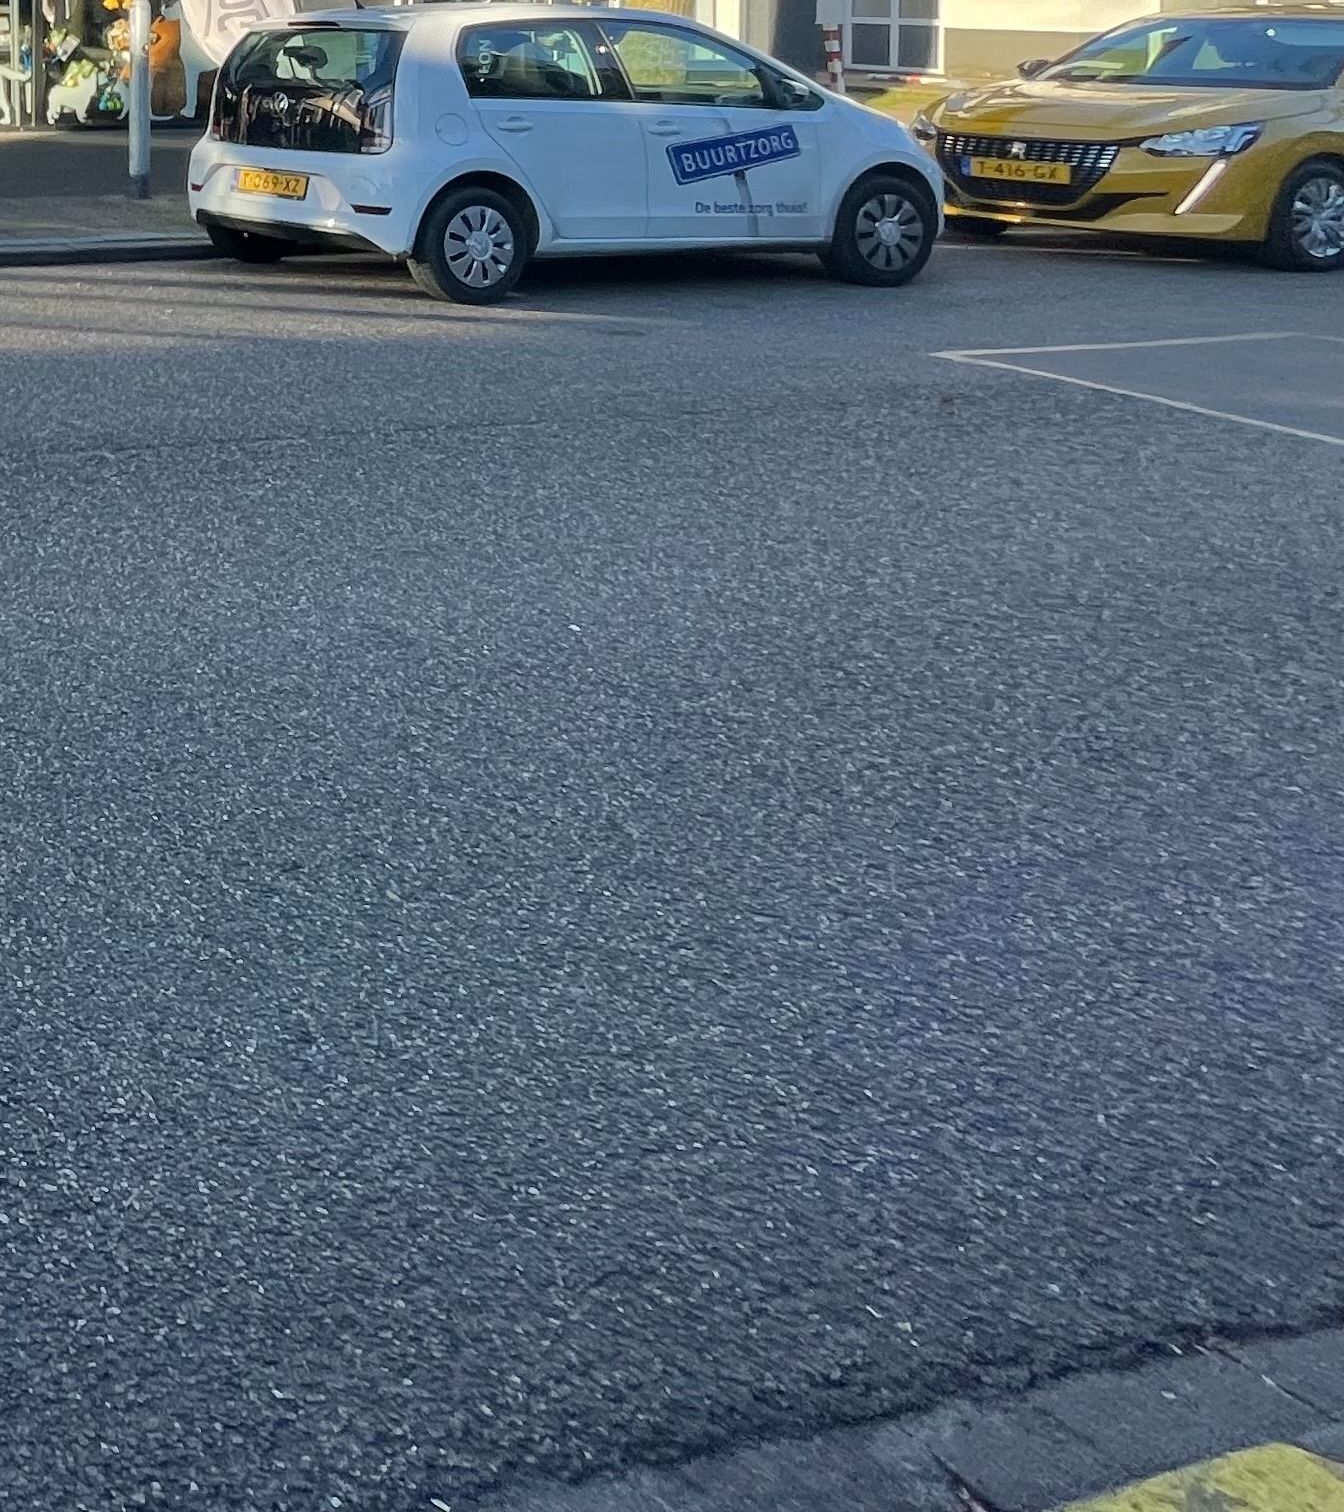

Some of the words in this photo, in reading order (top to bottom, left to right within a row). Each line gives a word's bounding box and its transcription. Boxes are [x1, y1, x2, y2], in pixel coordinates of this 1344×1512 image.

[681, 132, 794, 173] BUURTZORG
[695, 201, 711, 213] De
[714, 201, 746, 213] beste
[749, 203, 773, 217] zorg
